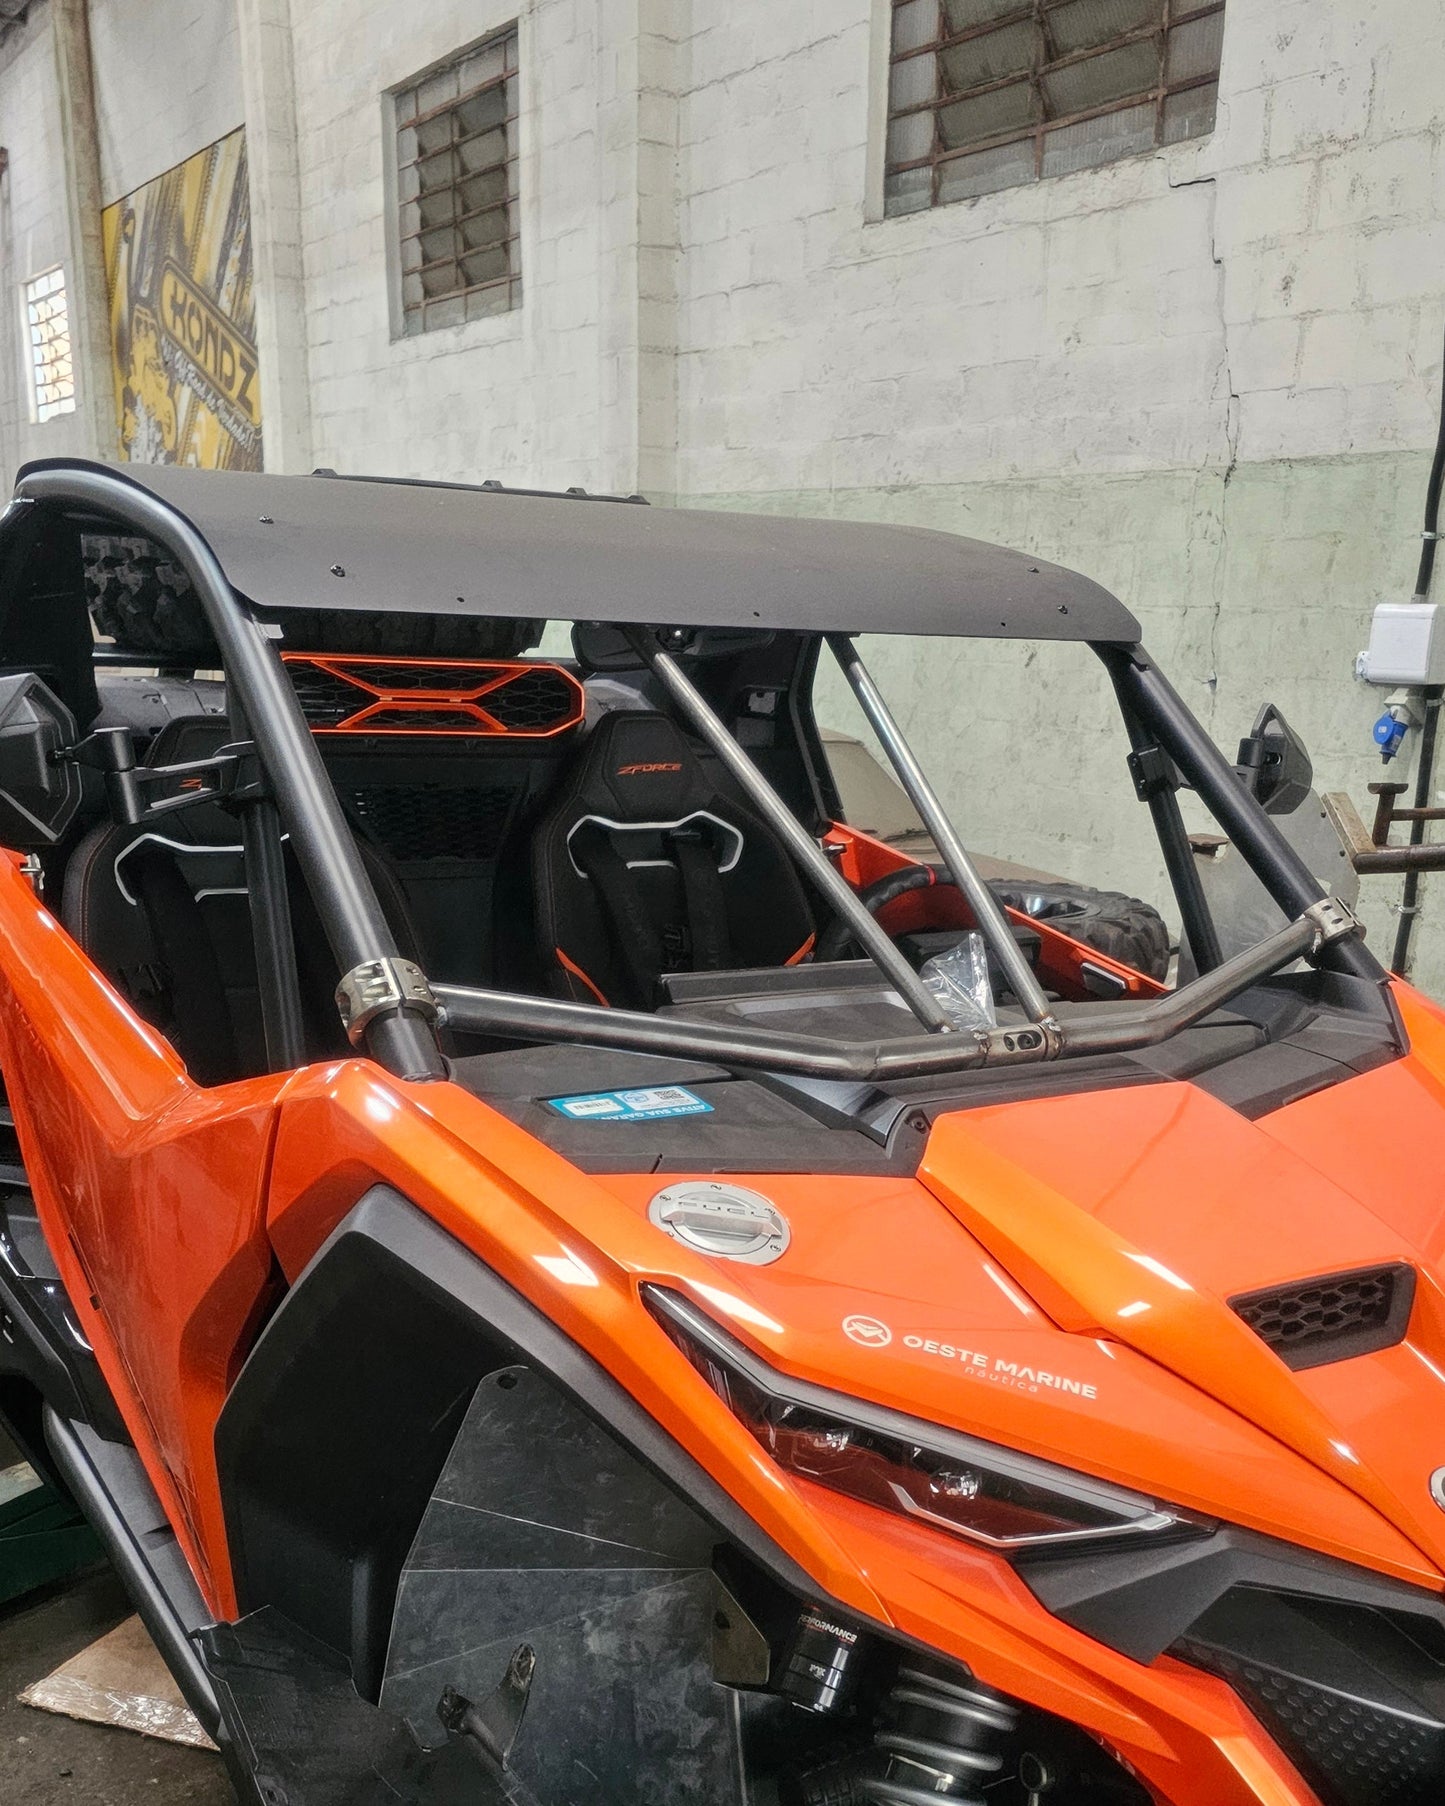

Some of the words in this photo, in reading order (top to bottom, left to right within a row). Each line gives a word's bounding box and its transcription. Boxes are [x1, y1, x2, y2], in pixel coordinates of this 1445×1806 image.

[617, 763, 682, 775] ZFORCE
[902, 1335, 989, 1369] OESTE
[994, 1359, 1098, 1400] MARINE
